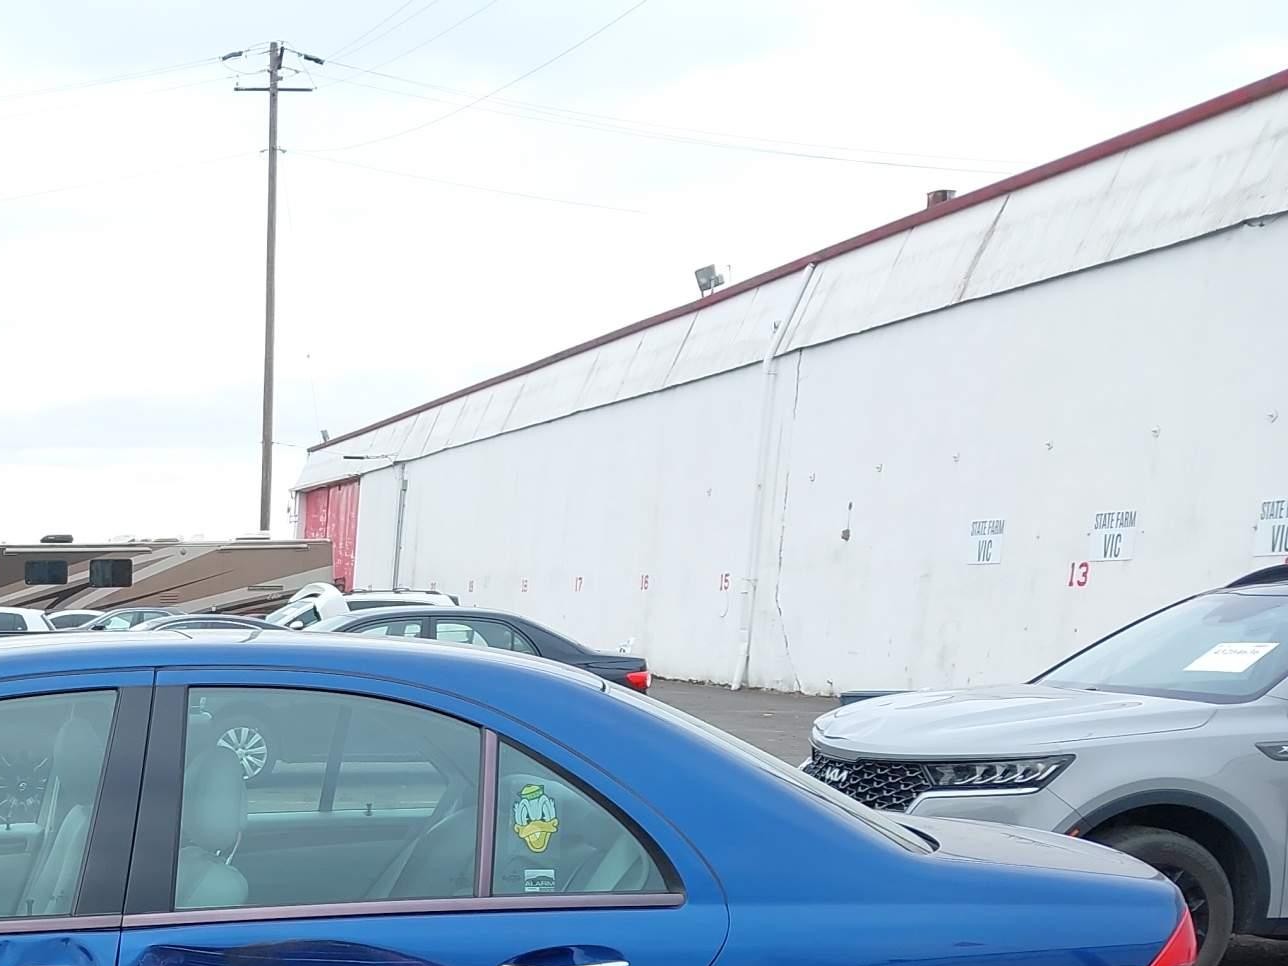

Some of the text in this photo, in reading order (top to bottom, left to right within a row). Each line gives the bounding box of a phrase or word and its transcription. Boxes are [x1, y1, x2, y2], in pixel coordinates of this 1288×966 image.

[1094, 510, 1136, 529] STATE FARM
[1260, 500, 1285, 520] STATE
[971, 519, 1005, 536] STATE FARM
[977, 539, 993, 561] VIC
[1103, 533, 1122, 558] VIC
[640, 574, 649, 591] 16
[719, 573, 730, 591] 15
[1068, 561, 1089, 587] 13
[574, 576, 583, 592] 17
